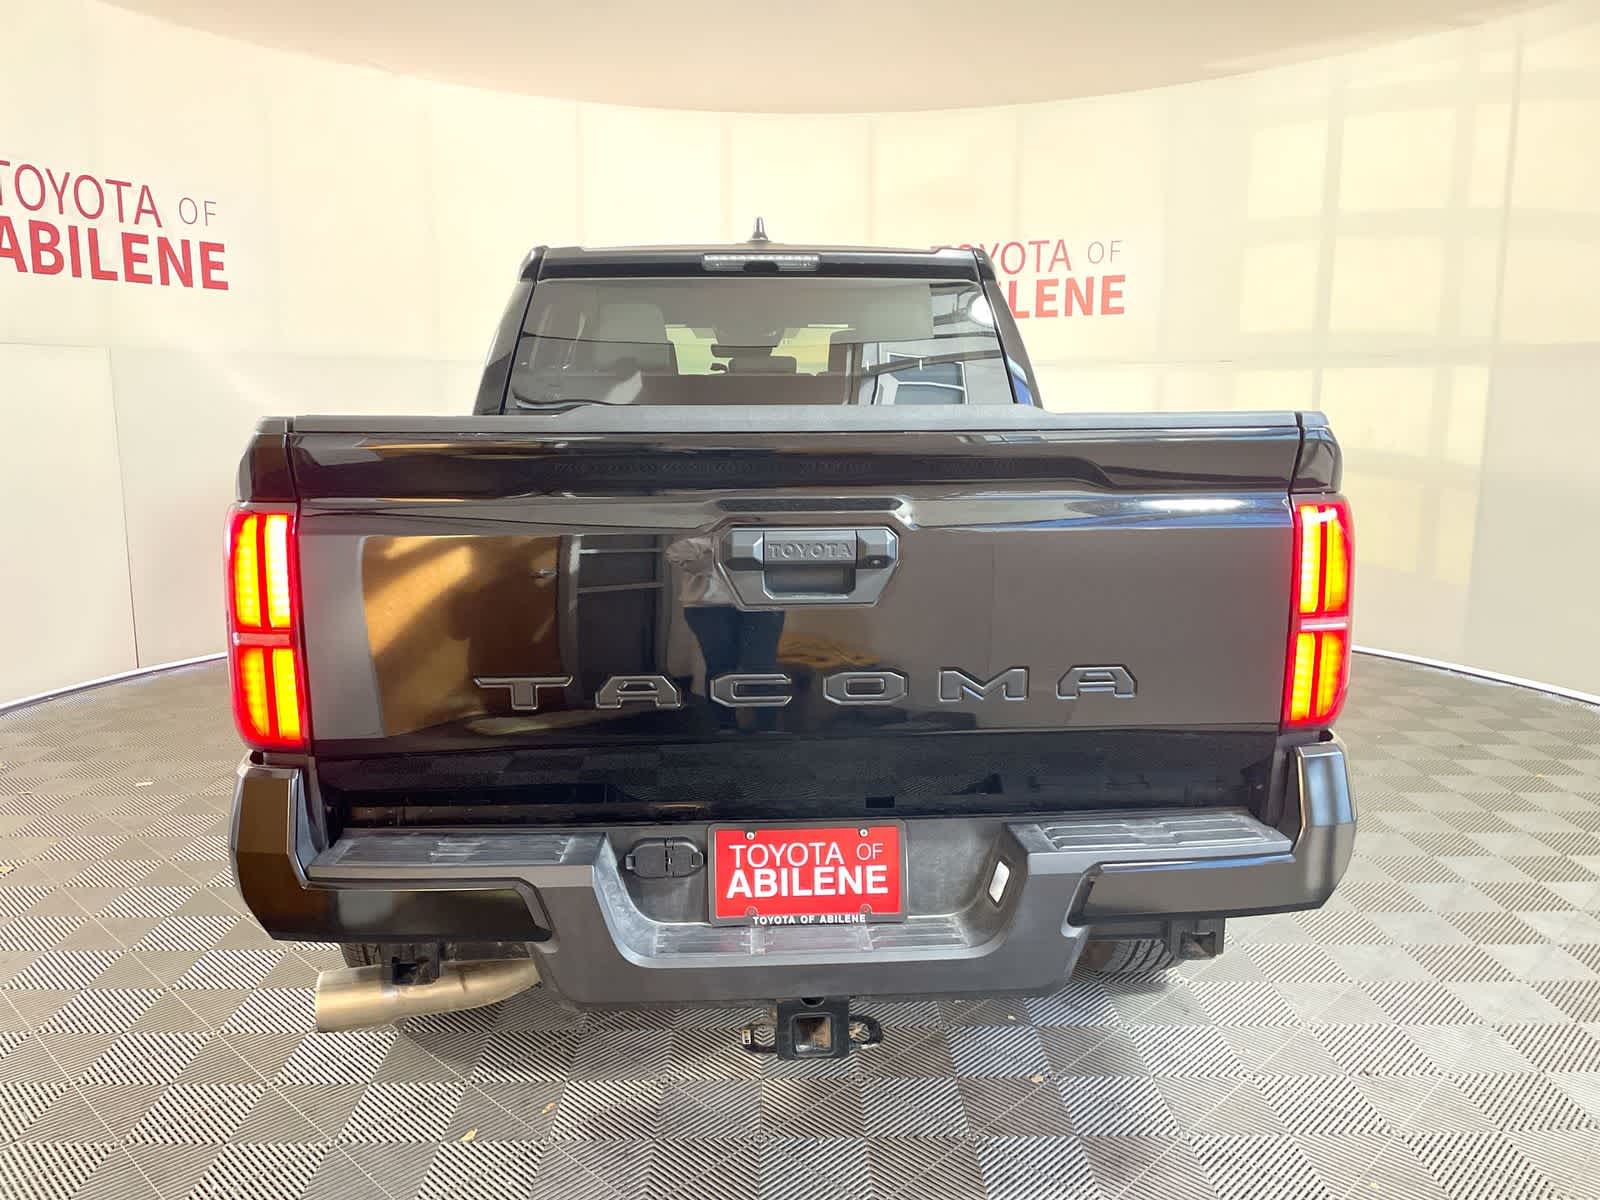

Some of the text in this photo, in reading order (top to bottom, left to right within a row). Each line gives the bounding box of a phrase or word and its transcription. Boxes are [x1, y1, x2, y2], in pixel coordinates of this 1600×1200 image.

[179, 197, 217, 227] OF
[0, 215, 229, 291] ABILENE
[930, 239, 1122, 275] OTA OF
[997, 274, 1126, 319] LENE
[767, 542, 853, 559] TOYOTA
[472, 665, 1139, 711] TACOMA
[729, 841, 884, 868] TOYOTA OF
[726, 864, 889, 899] ABILENE
[752, 913, 866, 925] TOYOTA OF ABILENE
